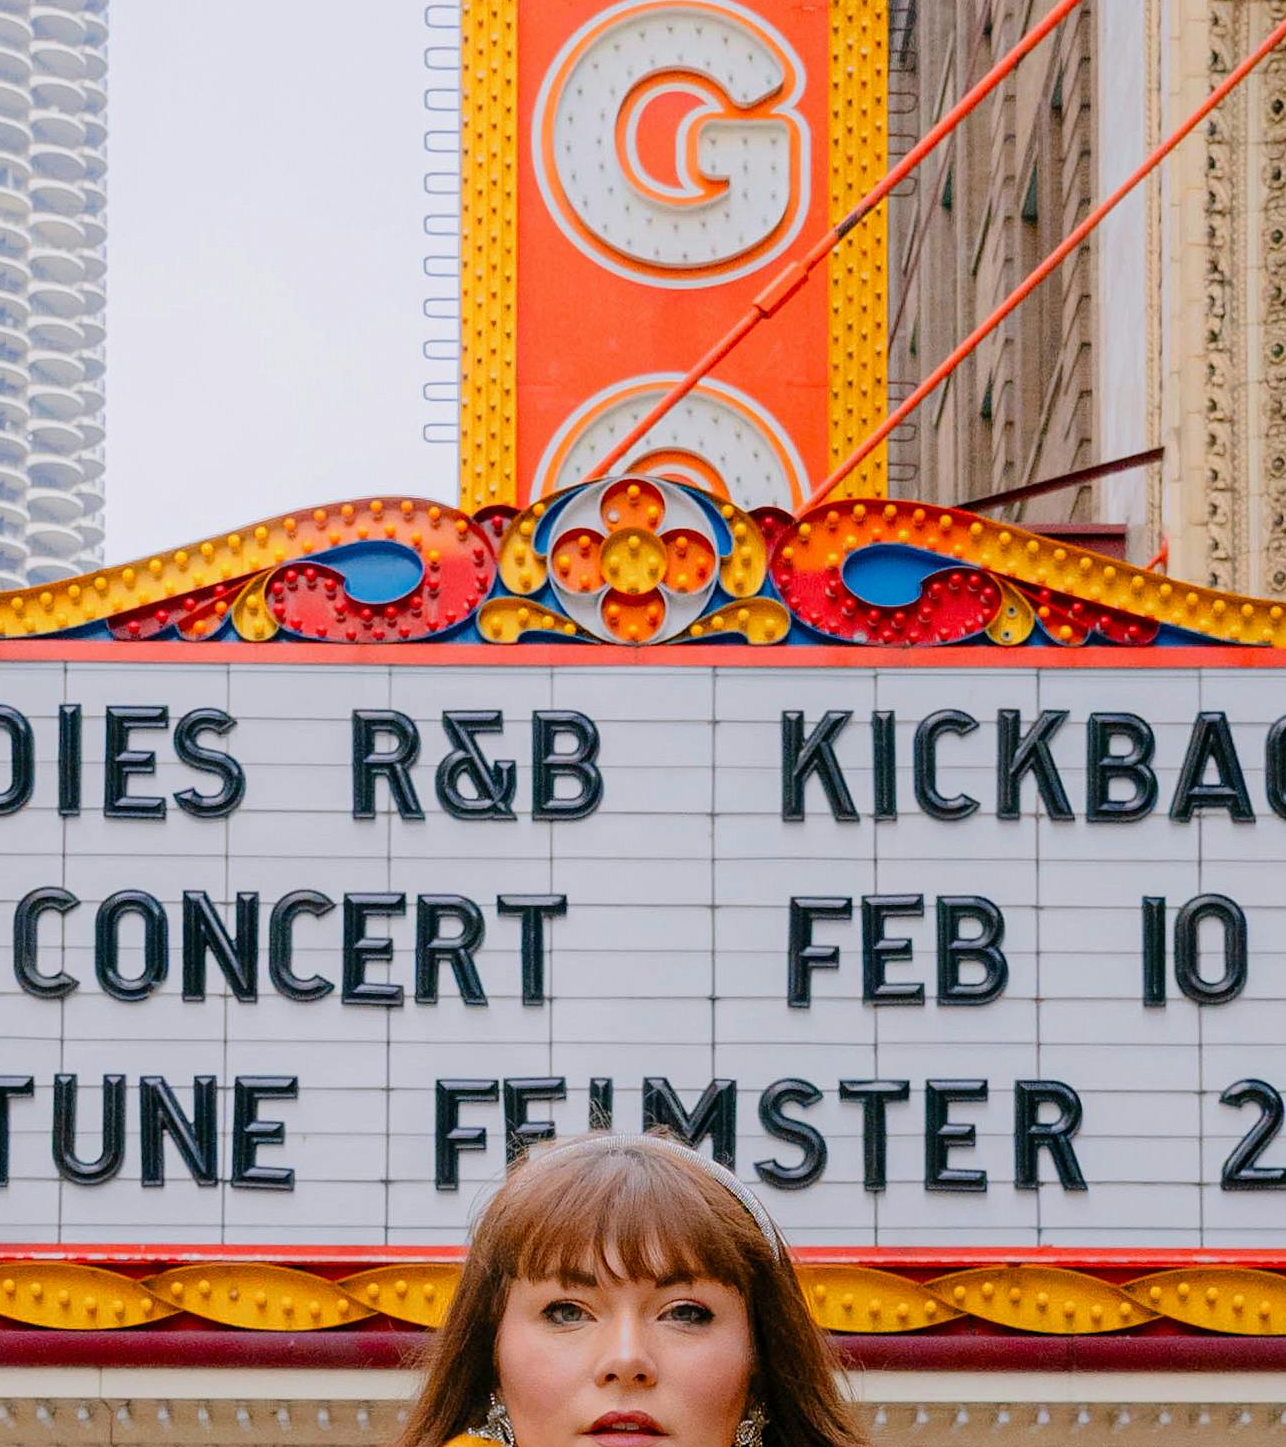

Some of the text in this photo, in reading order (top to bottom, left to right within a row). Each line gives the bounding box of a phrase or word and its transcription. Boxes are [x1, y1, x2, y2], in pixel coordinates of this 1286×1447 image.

[351, 709, 604, 821] R&B
[13, 886, 1248, 1008] CONCERT FEB 10
